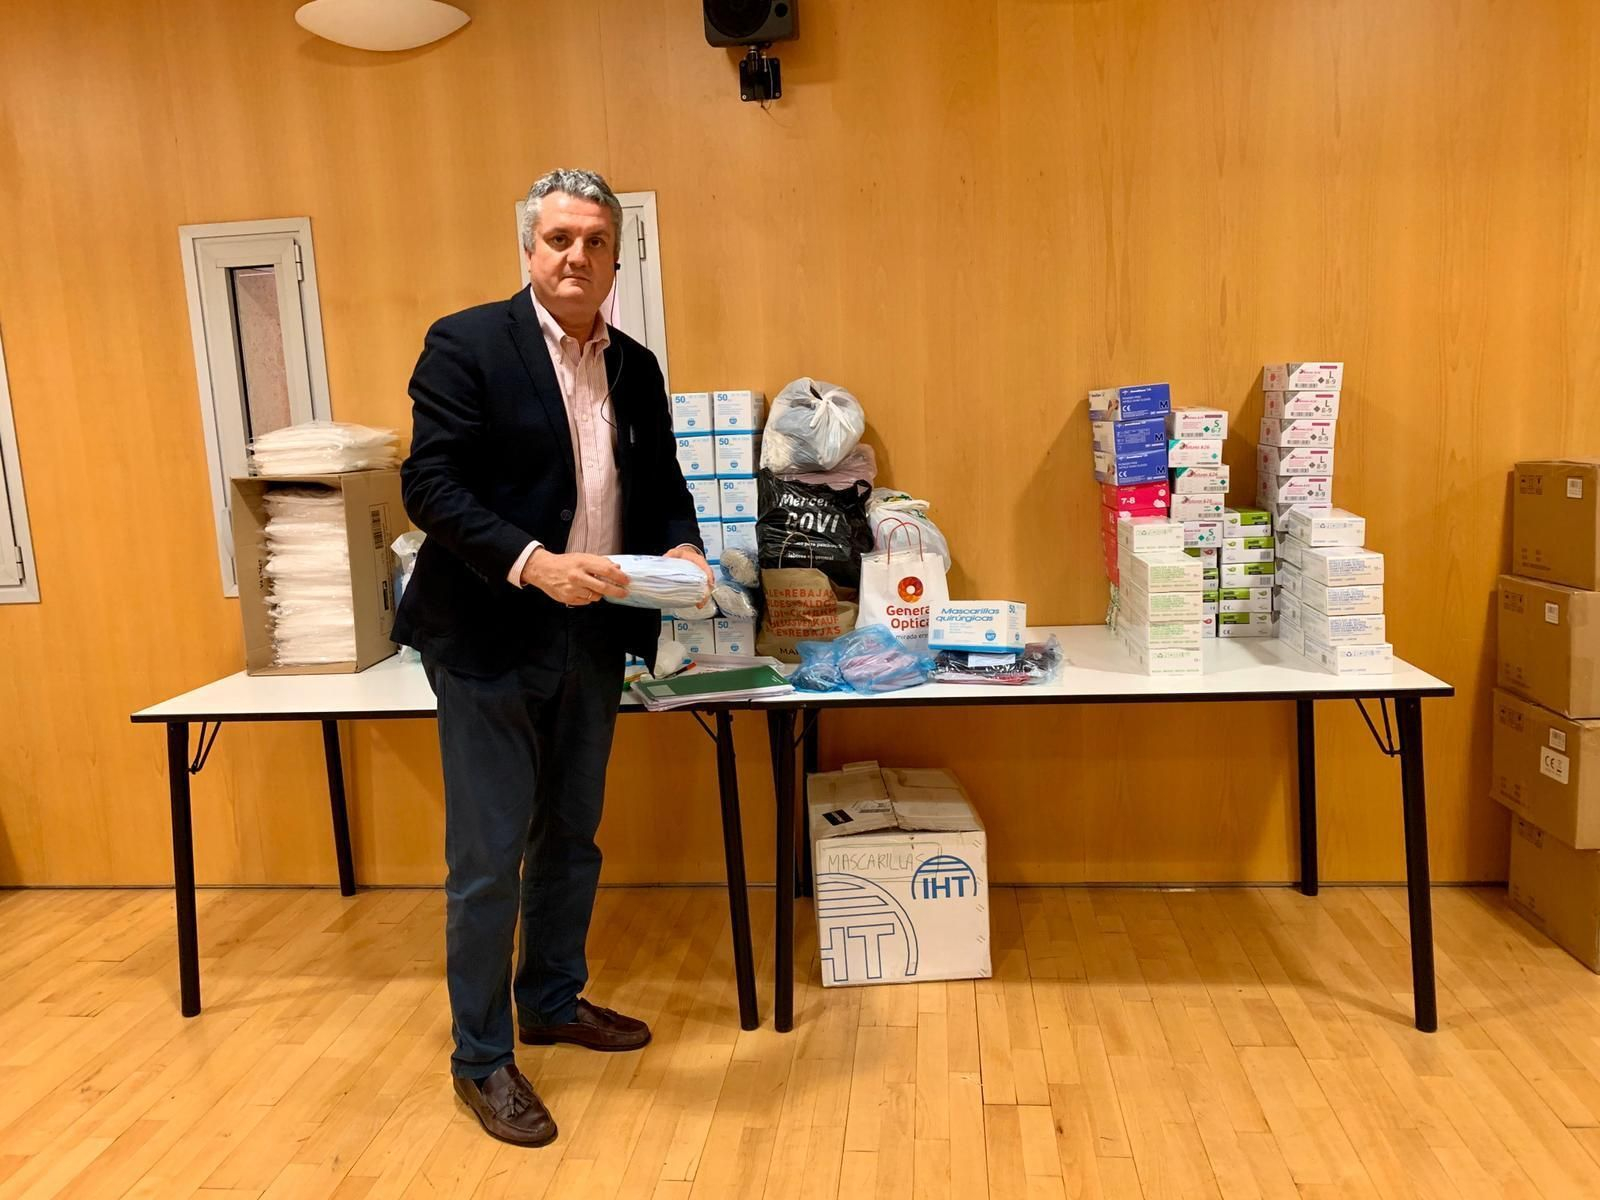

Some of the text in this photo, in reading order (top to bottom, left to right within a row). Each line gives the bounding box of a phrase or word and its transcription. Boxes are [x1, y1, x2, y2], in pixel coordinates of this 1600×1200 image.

[676, 396, 686, 404] 50
[1160, 400, 1168, 408] M
[1214, 420, 1220, 428] S
[726, 524, 737, 532] 50
[1208, 528, 1214, 536] S
[886, 606, 930, 616] Genera
[718, 620, 729, 629] 50
[828, 852, 925, 872] MASCARILLAS
[923, 876, 970, 900] IHT
